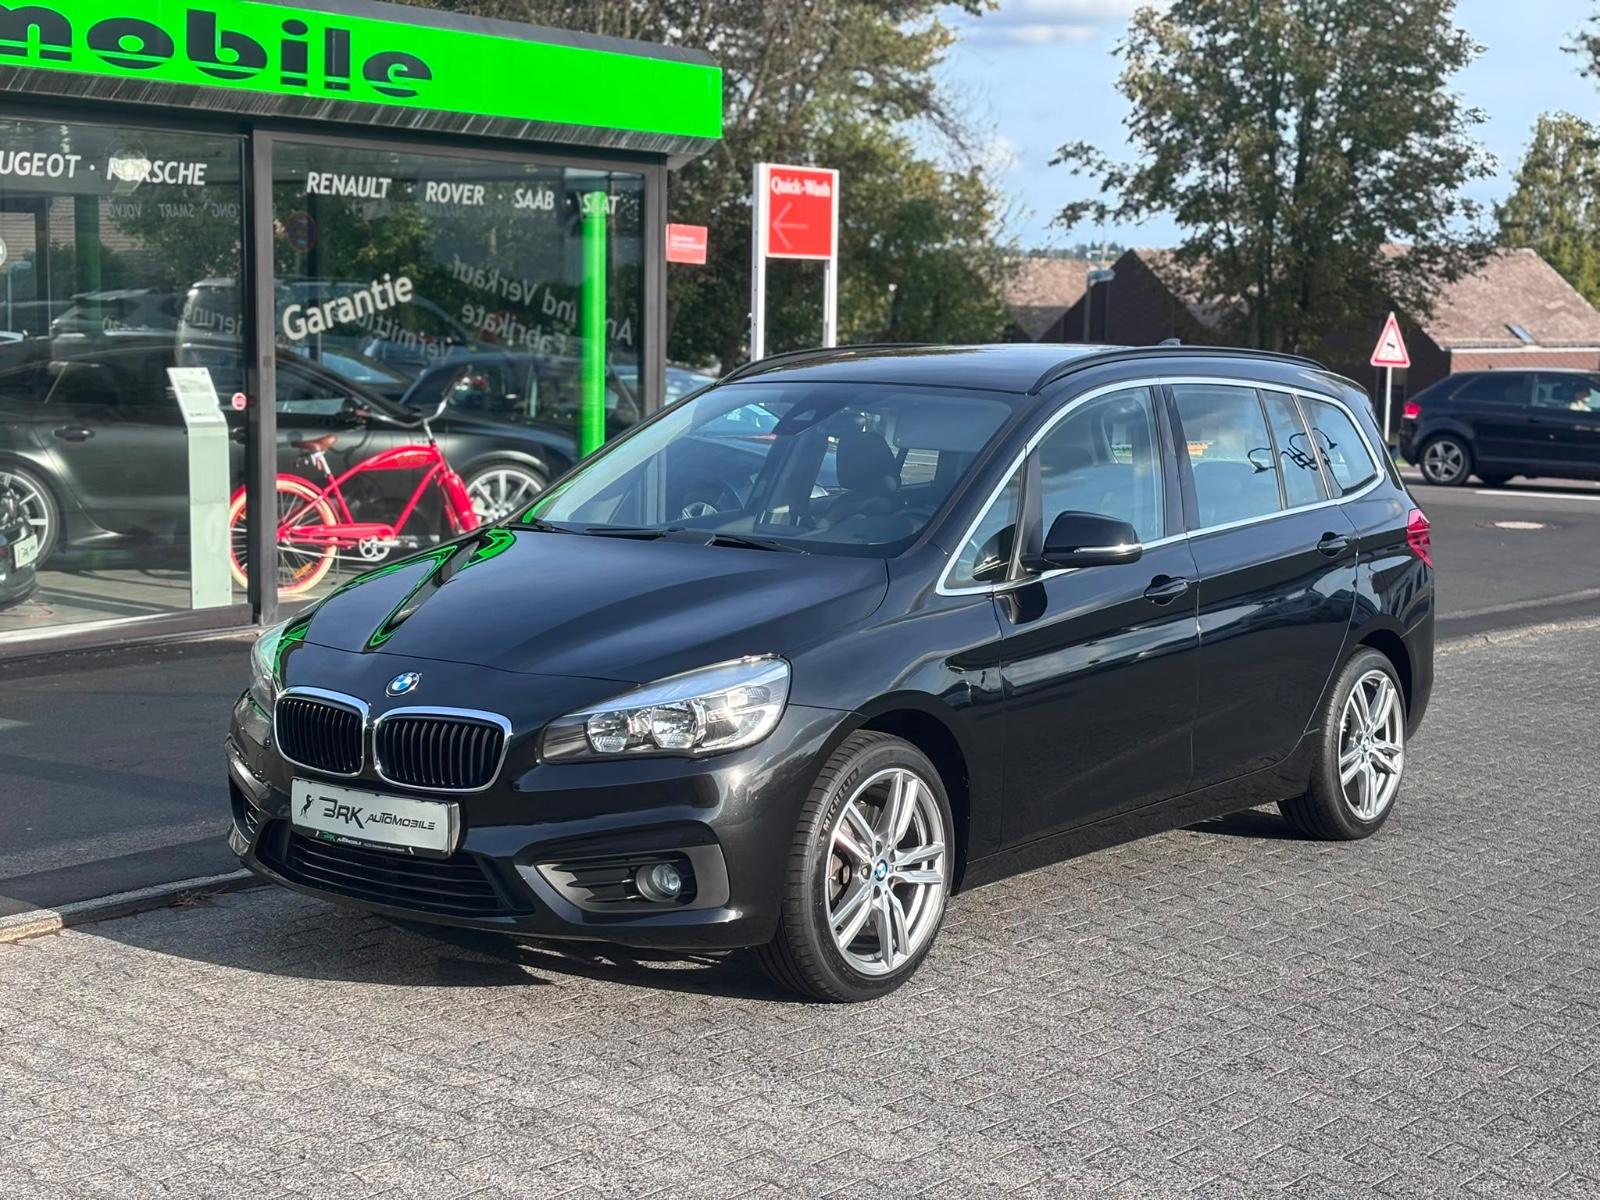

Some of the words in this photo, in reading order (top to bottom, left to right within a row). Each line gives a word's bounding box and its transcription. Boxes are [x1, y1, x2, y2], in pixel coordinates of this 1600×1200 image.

[106, 157, 207, 185] PRSCHE
[771, 176, 830, 197] Quick-Wash
[307, 172, 391, 199] RENAULT
[425, 181, 485, 206] ROVER
[514, 188, 555, 210] SAAB
[582, 193, 620, 215] SAT
[282, 273, 413, 341] Garantie
[822, 768, 860, 832] MICHELIN
